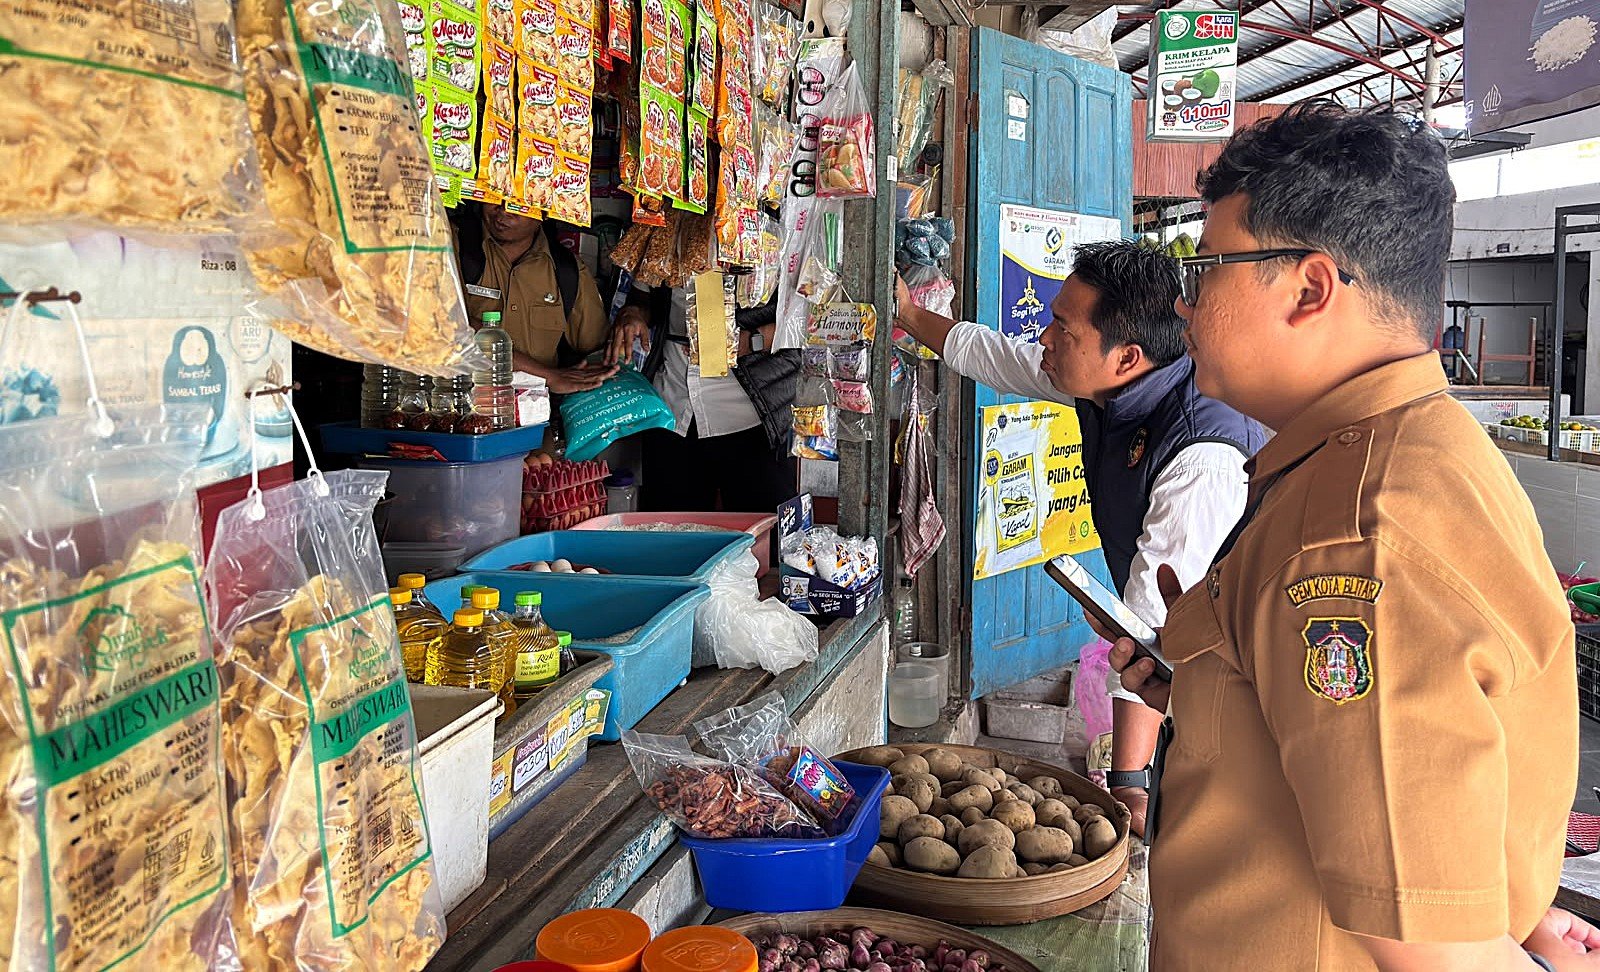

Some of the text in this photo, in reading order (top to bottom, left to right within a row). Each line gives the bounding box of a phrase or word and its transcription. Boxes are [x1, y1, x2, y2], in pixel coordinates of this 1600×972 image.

[432, 18, 475, 40] Masako
[1195, 14, 1233, 38] SUN
[1216, 15, 1233, 25] kara
[1165, 46, 1230, 61] KRIM KELAPA
[433, 101, 470, 124] Masako
[1182, 102, 1229, 122] 110ml
[201, 260, 219, 271] Riza
[225, 261, 236, 271] 08
[1044, 256, 1066, 266] GARAM
[813, 316, 866, 335] Harmony
[1048, 443, 1082, 458] Jangan
[1002, 458, 1027, 476] GARAM
[1047, 467, 1071, 485] Pilih
[1046, 495, 1077, 519] yang
[1290, 576, 1377, 600] PEM KOTA BLITAR
[138, 668, 164, 684] FROM
[164, 651, 198, 669] BLITAR
[48, 666, 214, 771] MAHESWARI
[321, 682, 407, 749] MAHESWARI
